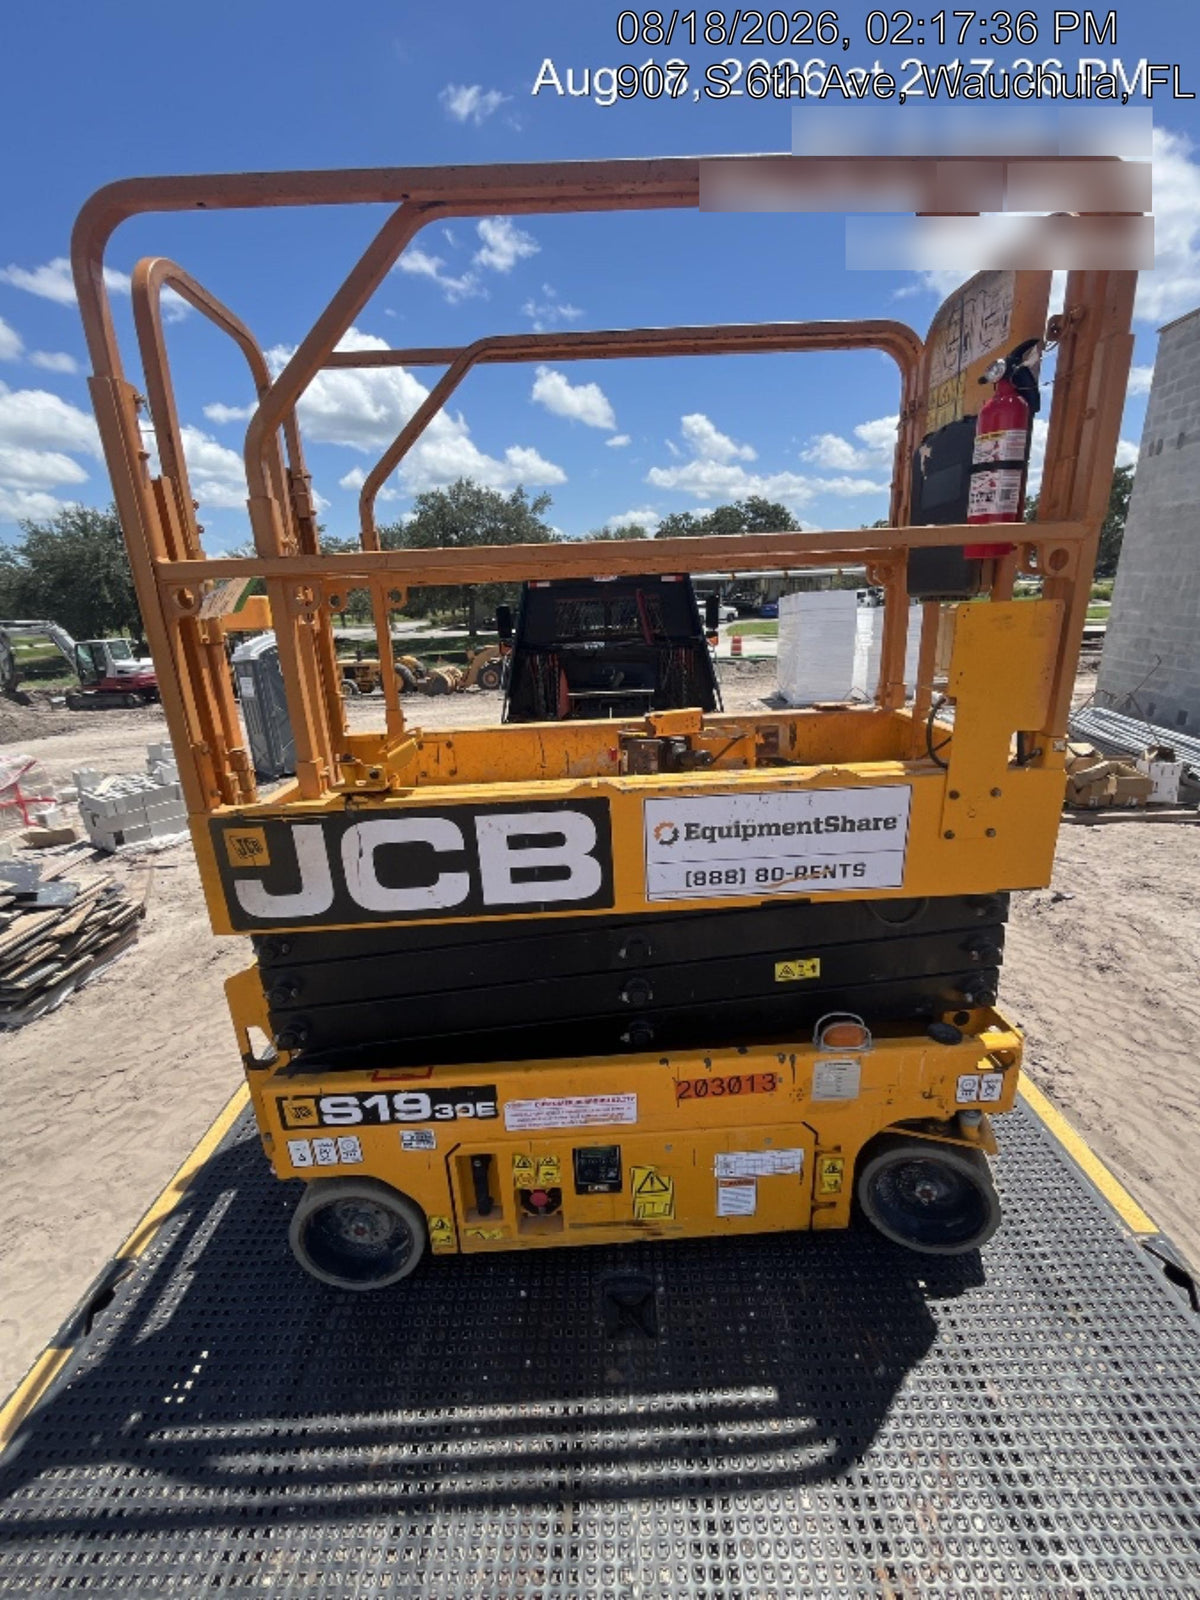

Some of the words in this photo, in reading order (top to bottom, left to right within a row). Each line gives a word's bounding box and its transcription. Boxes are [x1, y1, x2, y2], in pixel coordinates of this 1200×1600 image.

[684, 815, 897, 843] EquipmentShare
[234, 810, 602, 918] JCB
[755, 862, 867, 882] 80-RENTS
[677, 1073, 776, 1099] 203013
